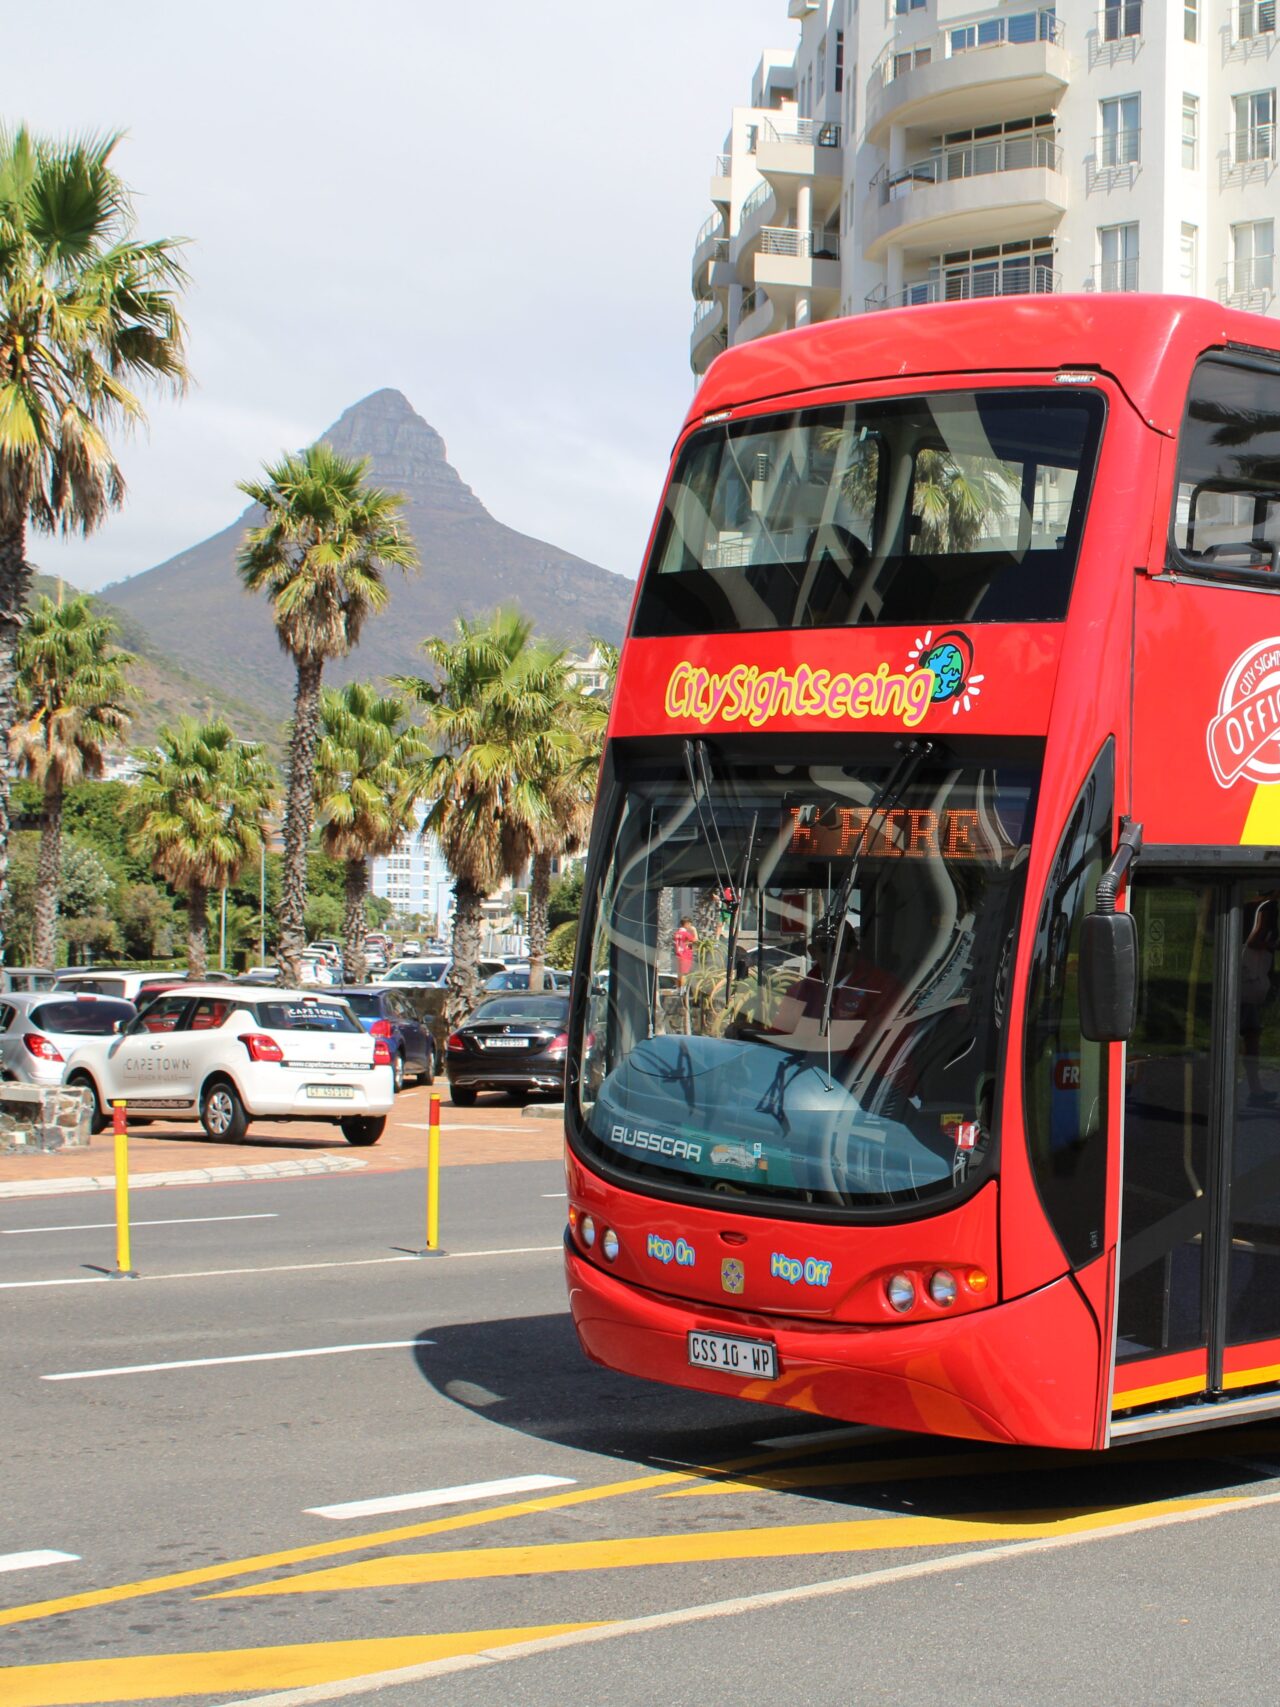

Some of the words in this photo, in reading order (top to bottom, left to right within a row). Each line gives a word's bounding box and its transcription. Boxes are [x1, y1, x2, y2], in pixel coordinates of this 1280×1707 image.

[665, 661, 935, 727] CitySightseeing
[1239, 667, 1256, 696] CITY
[837, 808, 979, 858] HIRE
[126, 1058, 153, 1070] CAPE
[156, 1058, 189, 1070] TOWN
[610, 1125, 702, 1162] BUSSCAR
[647, 1233, 674, 1264] Hop
[675, 1237, 695, 1266] On
[771, 1252, 803, 1285] Hop
[804, 1256, 832, 1286] Off
[692, 1337, 717, 1362] CSS
